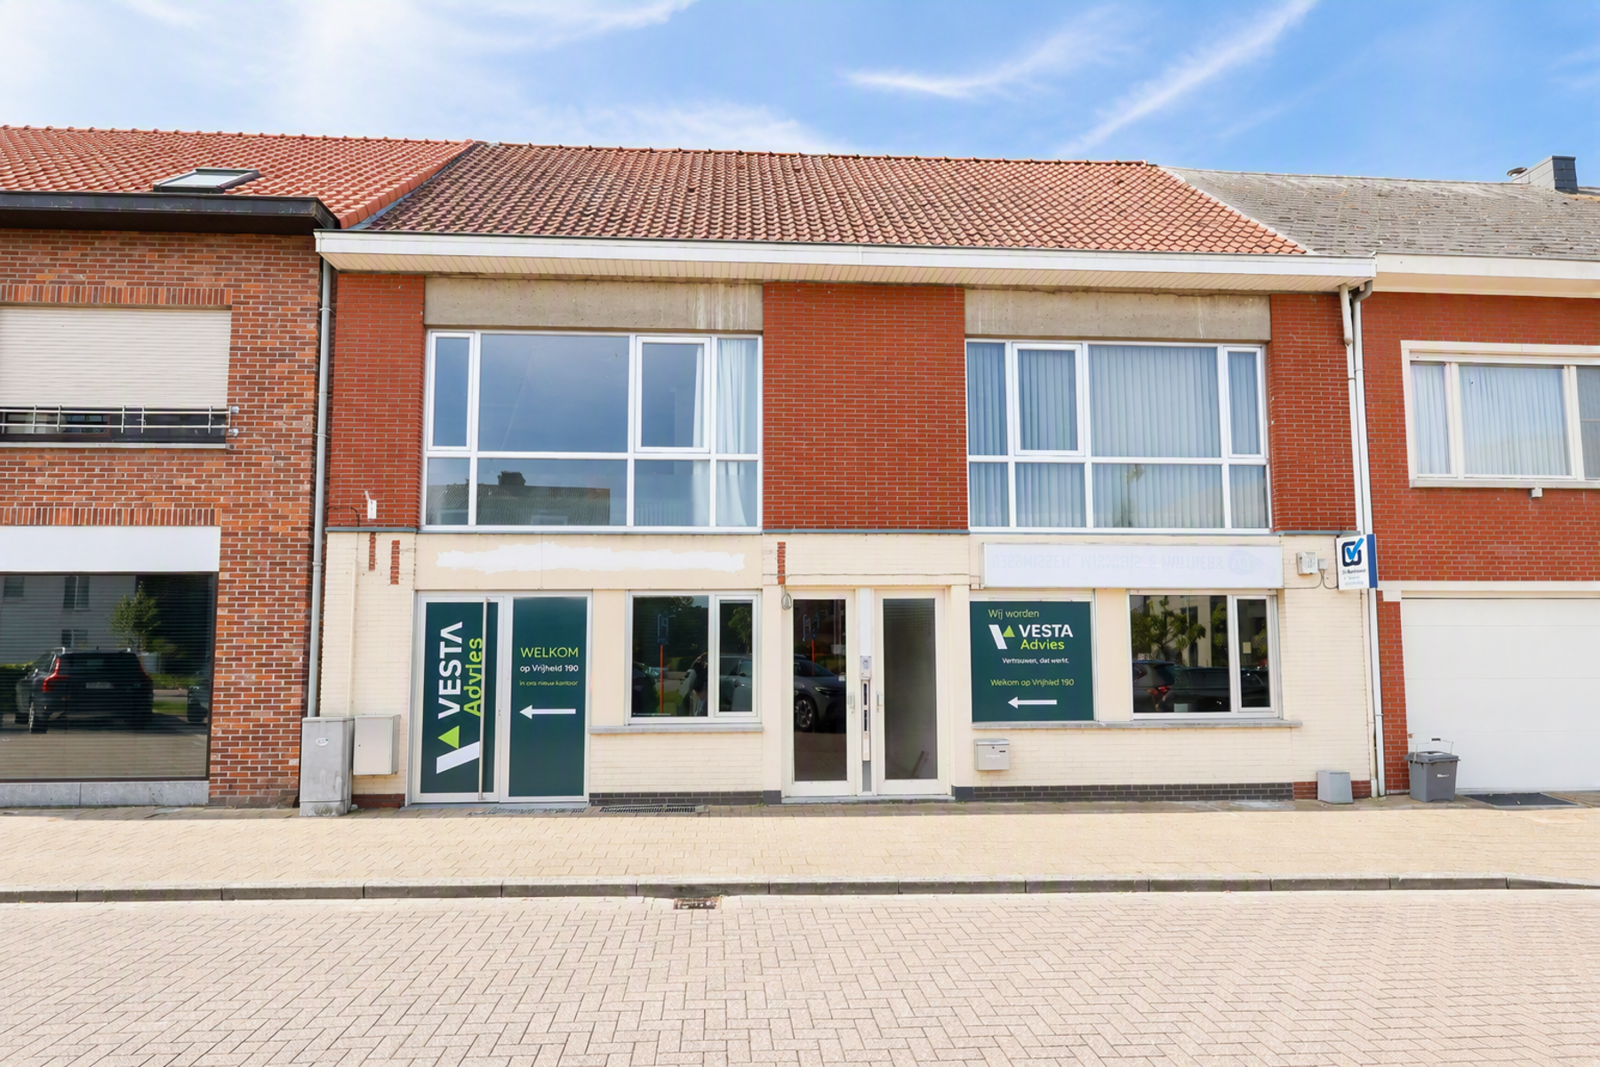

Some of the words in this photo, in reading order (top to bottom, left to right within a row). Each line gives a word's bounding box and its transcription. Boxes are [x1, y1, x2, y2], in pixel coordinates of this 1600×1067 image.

[988, 609, 1003, 620] Wij
[1005, 609, 1039, 618] worden
[1018, 624, 1074, 638] VESTA
[1020, 639, 1065, 650] Advies
[520, 647, 579, 658] WELKOM
[438, 621, 463, 719] VESTA
[519, 665, 531, 673] op
[532, 664, 563, 674] Vrijheid
[463, 637, 483, 717] Advies
[1032, 679, 1060, 688] Vrijheid
